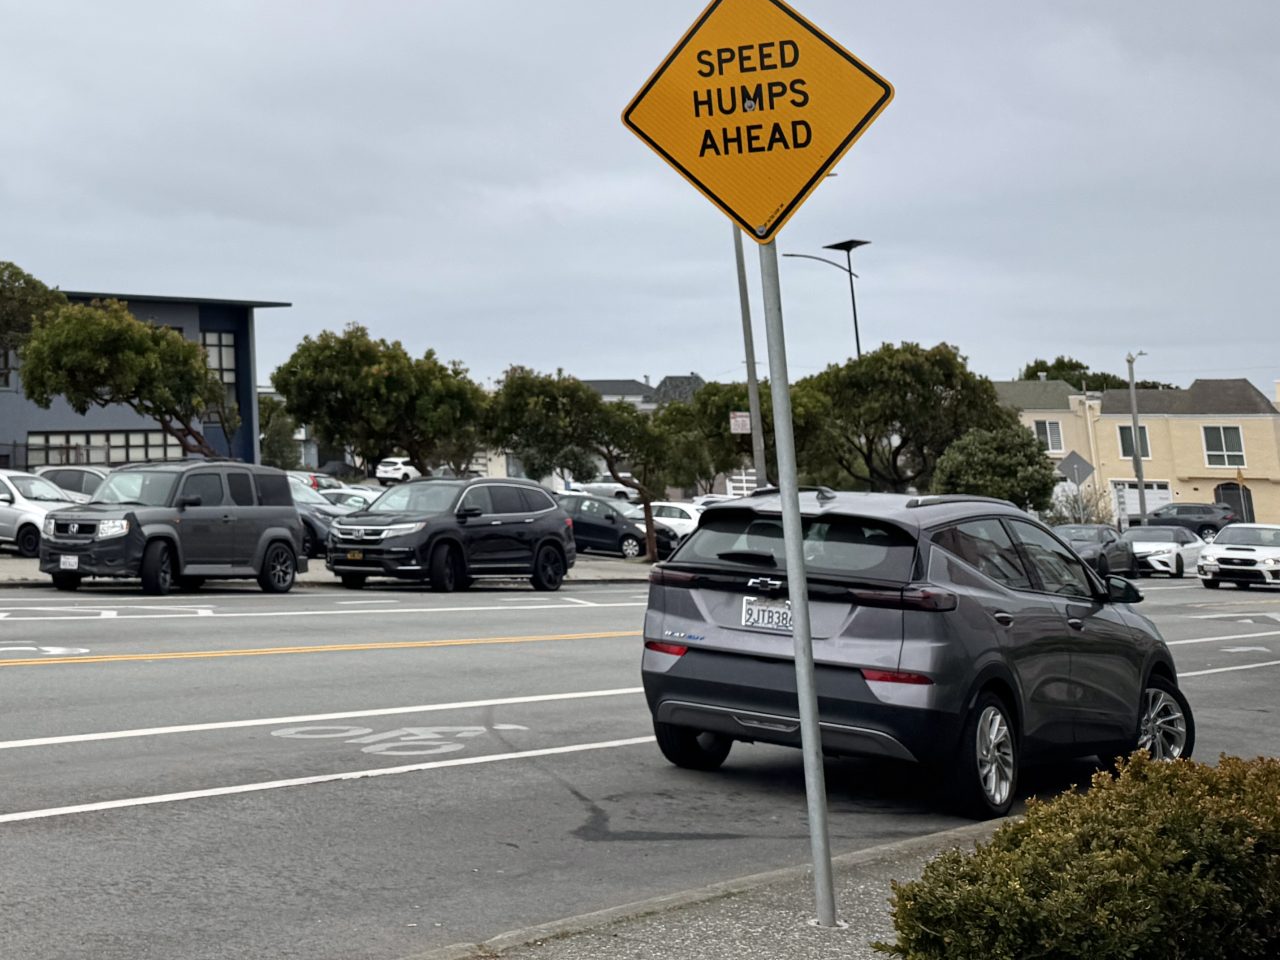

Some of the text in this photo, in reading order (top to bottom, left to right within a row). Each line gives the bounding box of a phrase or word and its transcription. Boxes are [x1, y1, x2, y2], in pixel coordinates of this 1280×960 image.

[696, 40, 800, 77] SPEED
[693, 78, 810, 118] HUMPS
[698, 120, 813, 157] AHEAD
